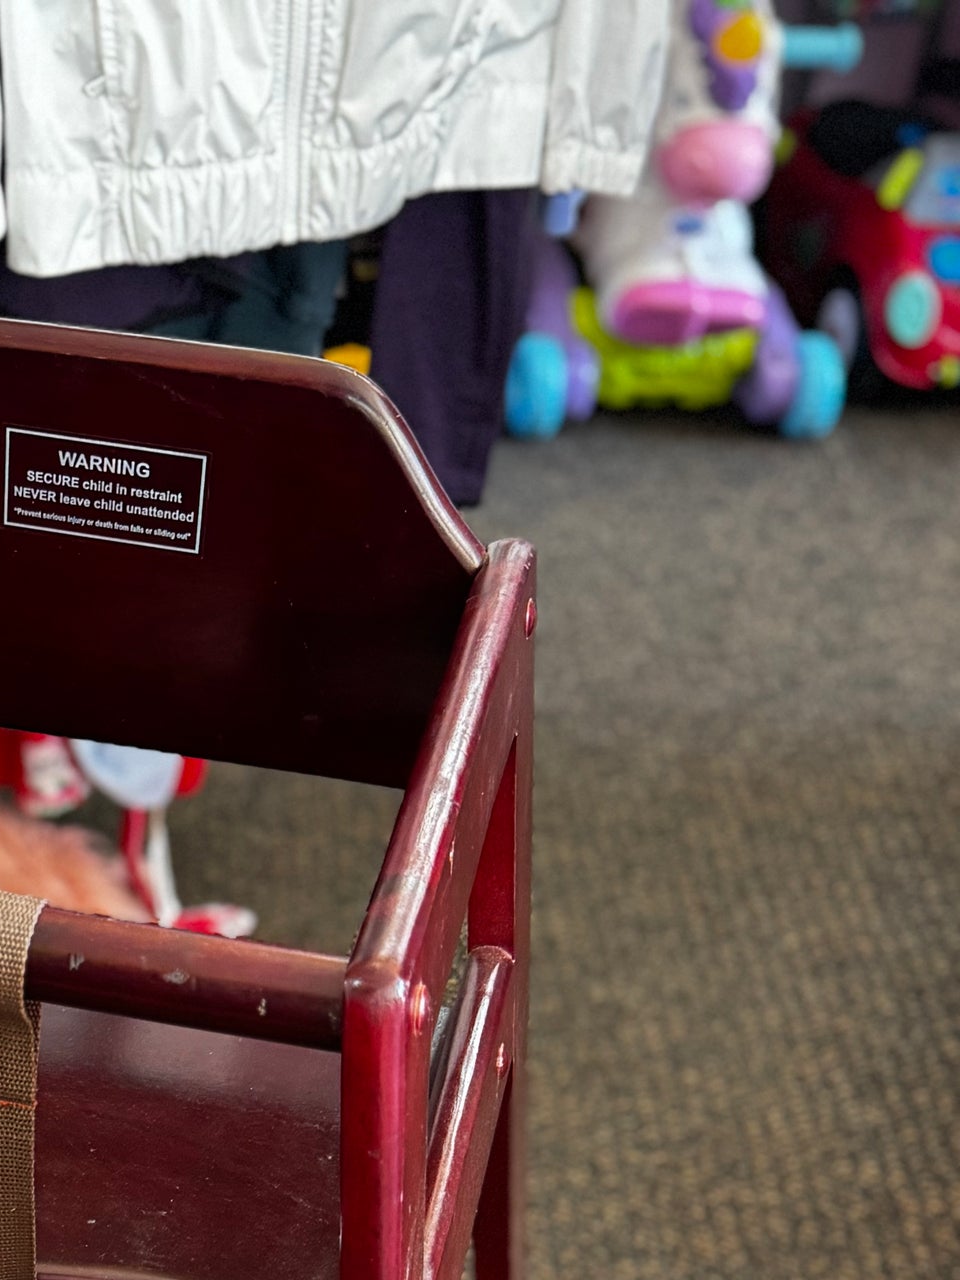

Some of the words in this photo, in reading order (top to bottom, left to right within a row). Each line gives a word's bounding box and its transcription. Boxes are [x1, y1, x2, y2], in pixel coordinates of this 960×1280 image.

[58, 450, 151, 478] WARNING
[26, 470, 80, 488] SECURE
[82, 479, 113, 493] child
[116, 483, 128, 495] in
[130, 487, 183, 503] restraint
[13, 485, 57, 502] NEVER
[60, 492, 91, 507] leave
[93, 498, 123, 512] child
[126, 504, 195, 522] unattended
[42, 512, 66, 522] serious
[67, 514, 86, 527] injury
[95, 519, 114, 529] death
[114, 521, 129, 532] from
[130, 523, 145, 534] falls
[153, 527, 176, 540] sliding
